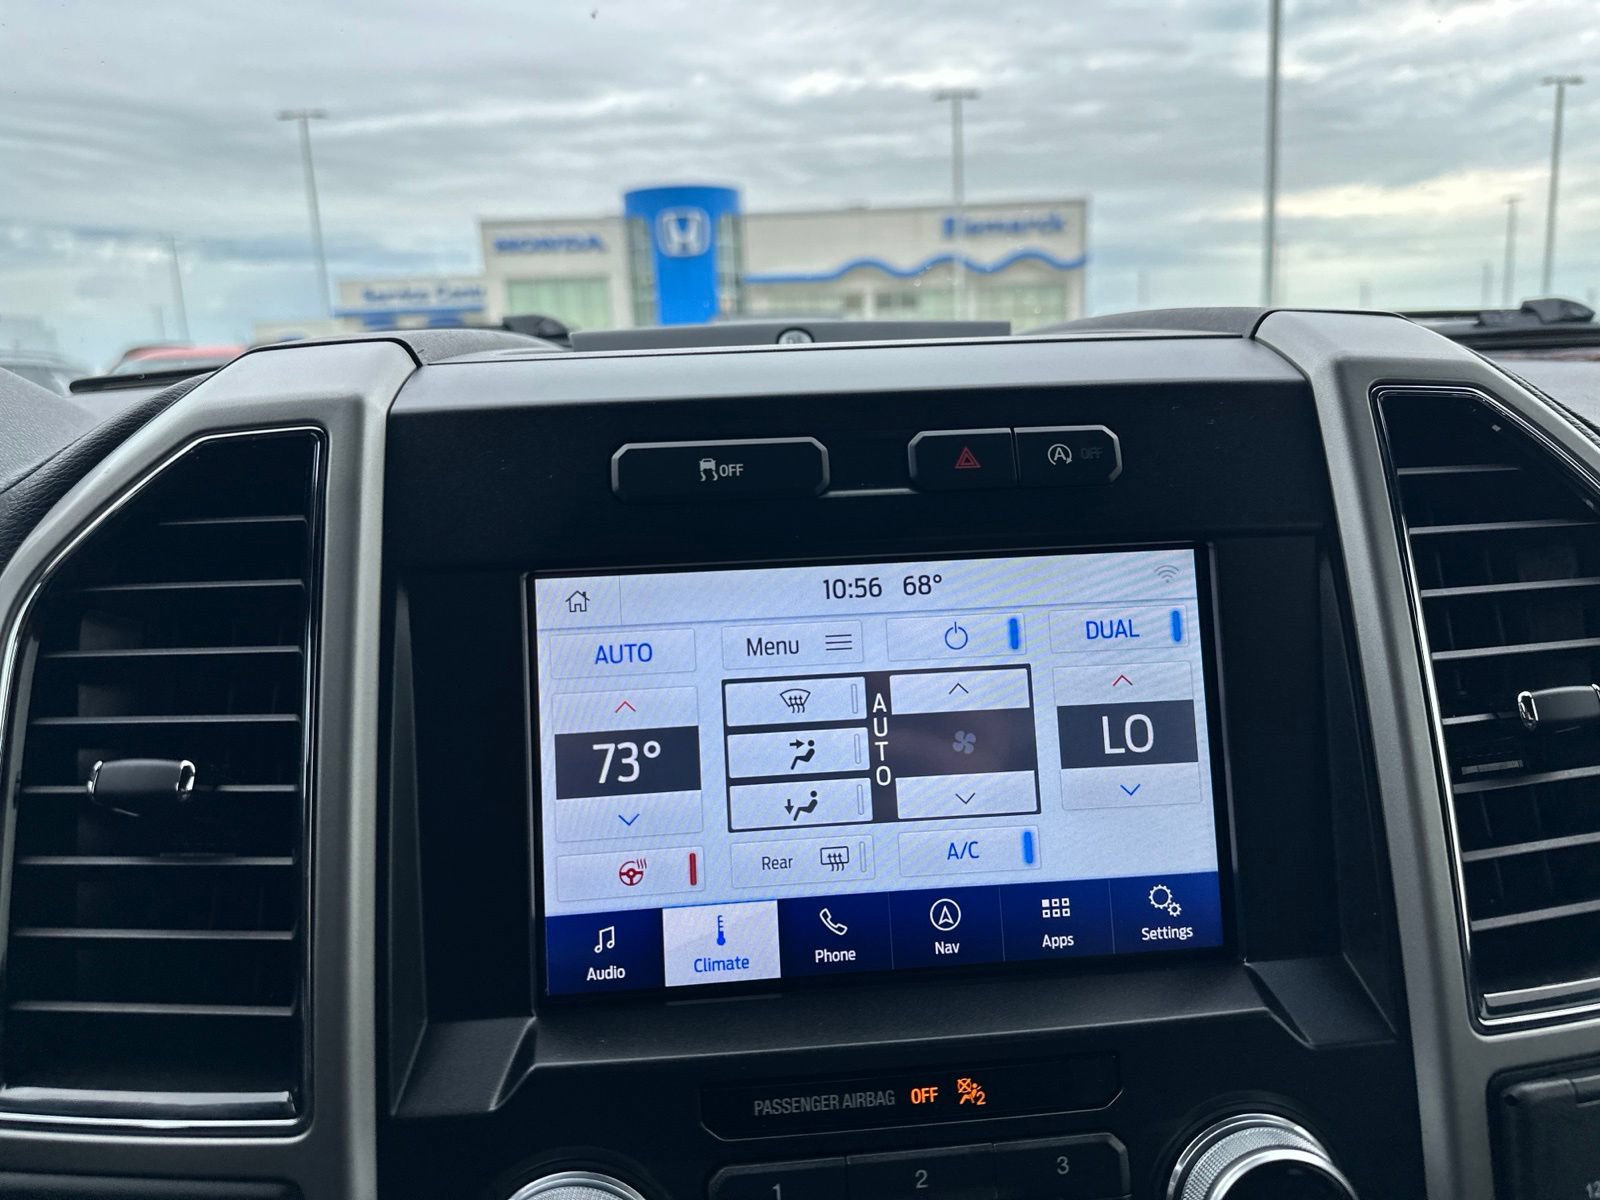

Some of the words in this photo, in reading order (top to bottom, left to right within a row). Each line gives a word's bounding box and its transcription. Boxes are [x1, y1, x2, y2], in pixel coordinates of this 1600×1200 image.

[719, 463, 744, 477] OFF
[822, 577, 882, 600] 10:56
[902, 574, 942, 596] 68°
[1085, 618, 1140, 640] DUAL
[594, 642, 653, 665] AUTO
[746, 637, 800, 657] Menu
[1101, 713, 1155, 755] LO
[592, 740, 661, 784] 73°
[947, 841, 980, 860] A/C
[761, 855, 793, 871] Rear
[1041, 933, 1074, 950] Apps
[1141, 925, 1194, 942] Settings
[815, 949, 856, 963] Phone
[934, 941, 960, 955] Nav
[586, 965, 626, 981] Audio
[693, 956, 750, 974] Climate
[753, 1094, 840, 1116] PASSENGER
[841, 1089, 896, 1109] AIRBAG
[910, 1086, 939, 1105] OFF
[1056, 1156, 1070, 1175] 3
[914, 1169, 929, 1189] 2
